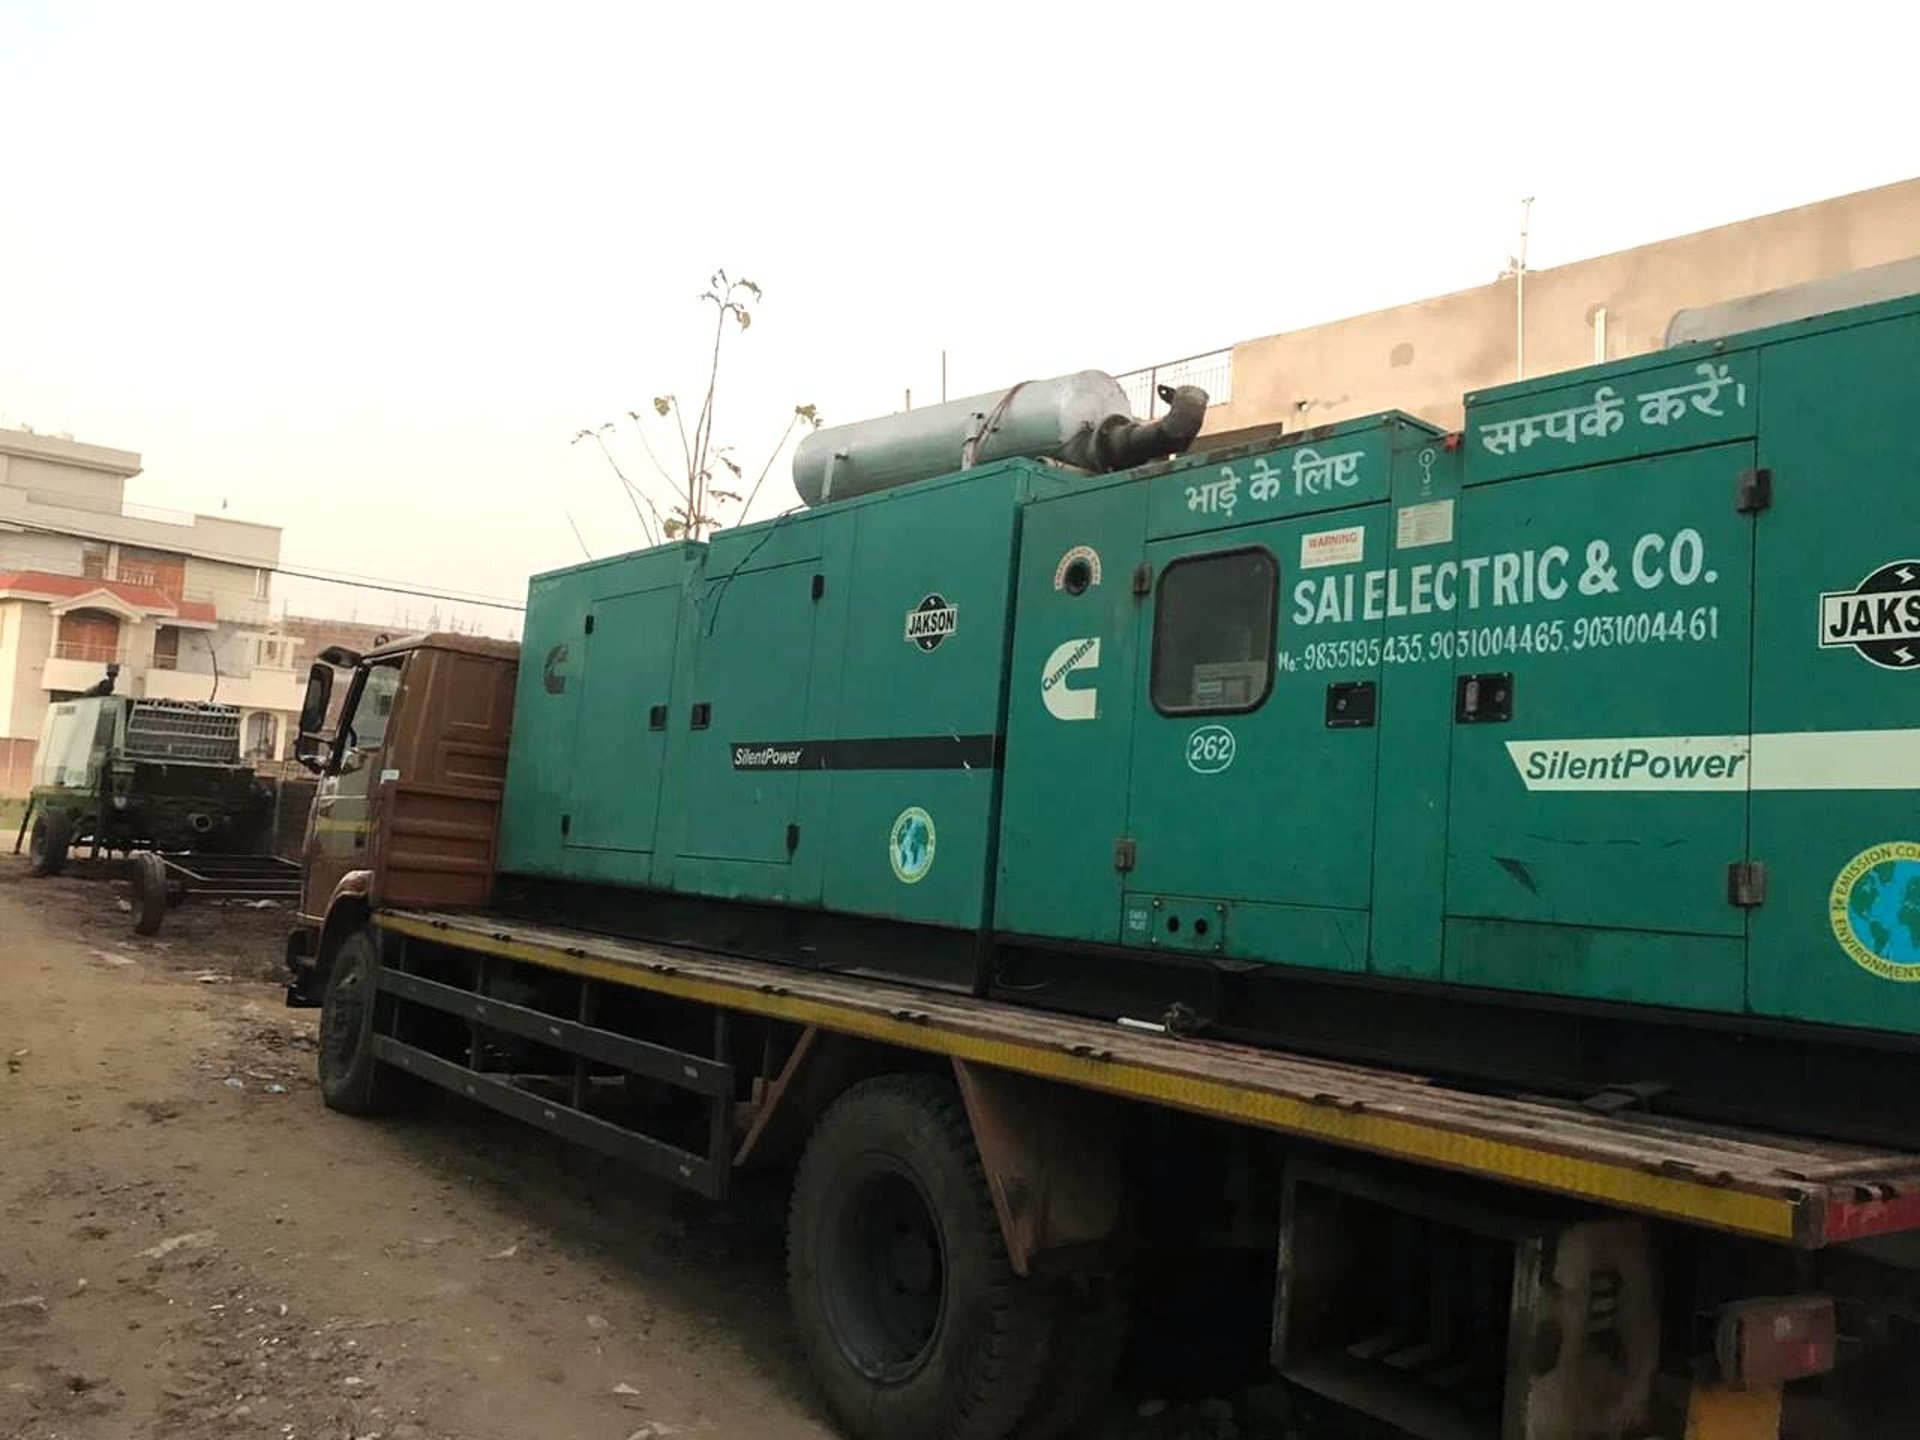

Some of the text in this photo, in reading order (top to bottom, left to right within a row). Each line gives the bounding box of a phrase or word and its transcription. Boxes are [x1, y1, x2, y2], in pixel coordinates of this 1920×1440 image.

[1479, 386, 1626, 455] सम्पर्क
[1185, 447, 1366, 517] भाड़े के लिए
[1307, 531, 1358, 549] WARNING
[1292, 527, 1719, 626] SAI ELECTRIC & CO.
[908, 609, 955, 636] JAKSON
[1571, 606, 1719, 650] 9031004461
[1829, 594, 1920, 638] JAKS
[1042, 637, 1096, 692] Cummins
[734, 747, 802, 766] SilentPower
[1190, 734, 1231, 761] 262
[1525, 748, 1747, 780] SilentPower
[1834, 845, 1892, 896] EMISSION
